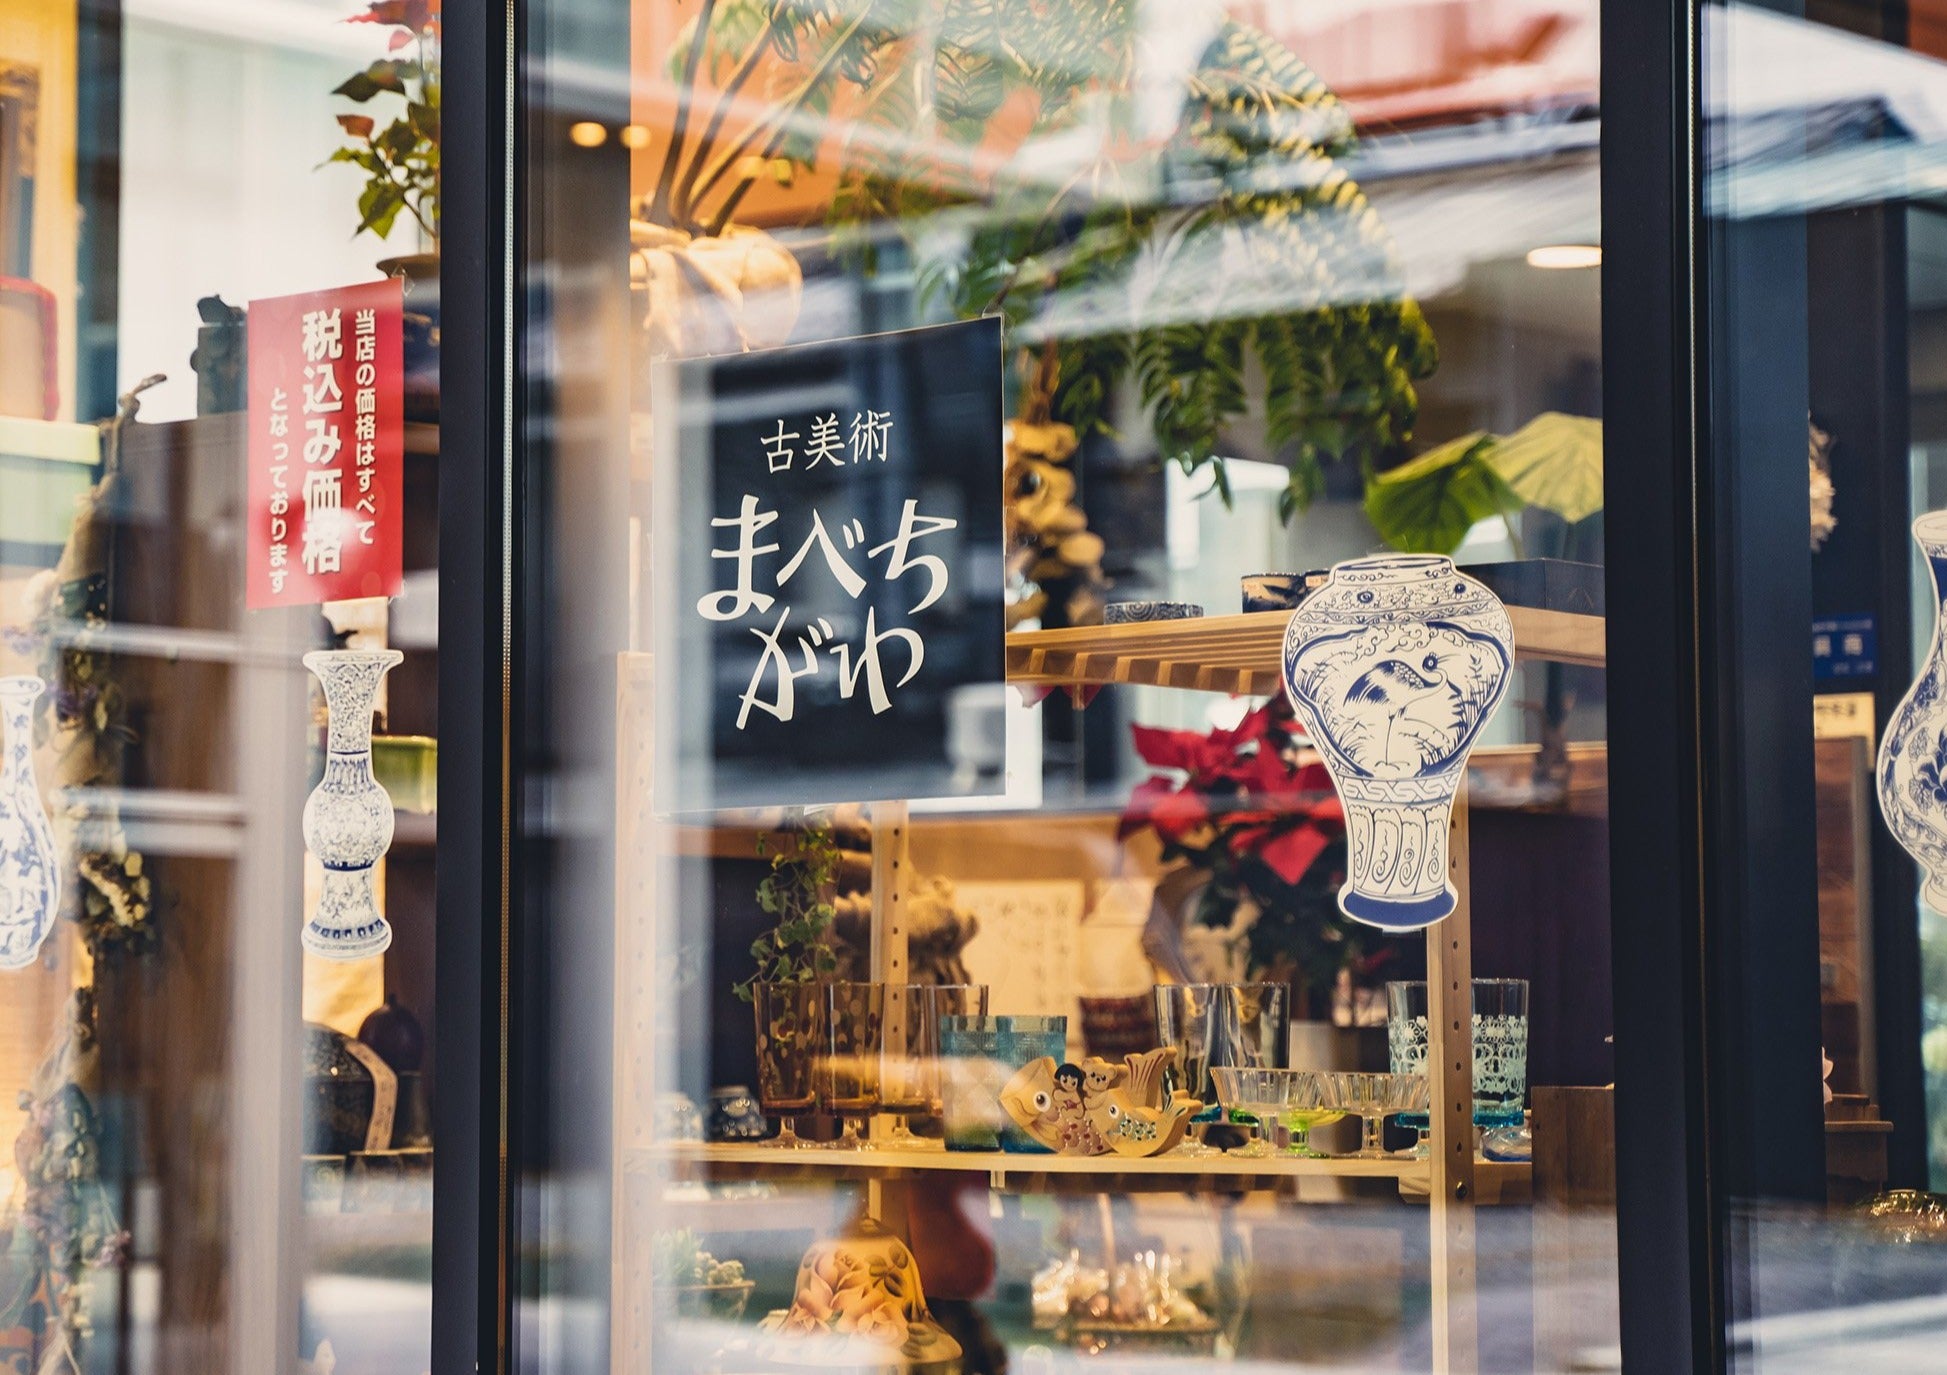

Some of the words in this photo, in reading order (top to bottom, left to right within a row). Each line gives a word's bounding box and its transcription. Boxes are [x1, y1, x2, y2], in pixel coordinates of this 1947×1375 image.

[269, 387, 289, 594] となっております
[302, 308, 343, 575] 税込み価格
[355, 309, 376, 545] 当店の価格はすべて
[760, 409, 894, 474] 古美術
[696, 494, 957, 621] まべち
[735, 606, 924, 730] がわ
